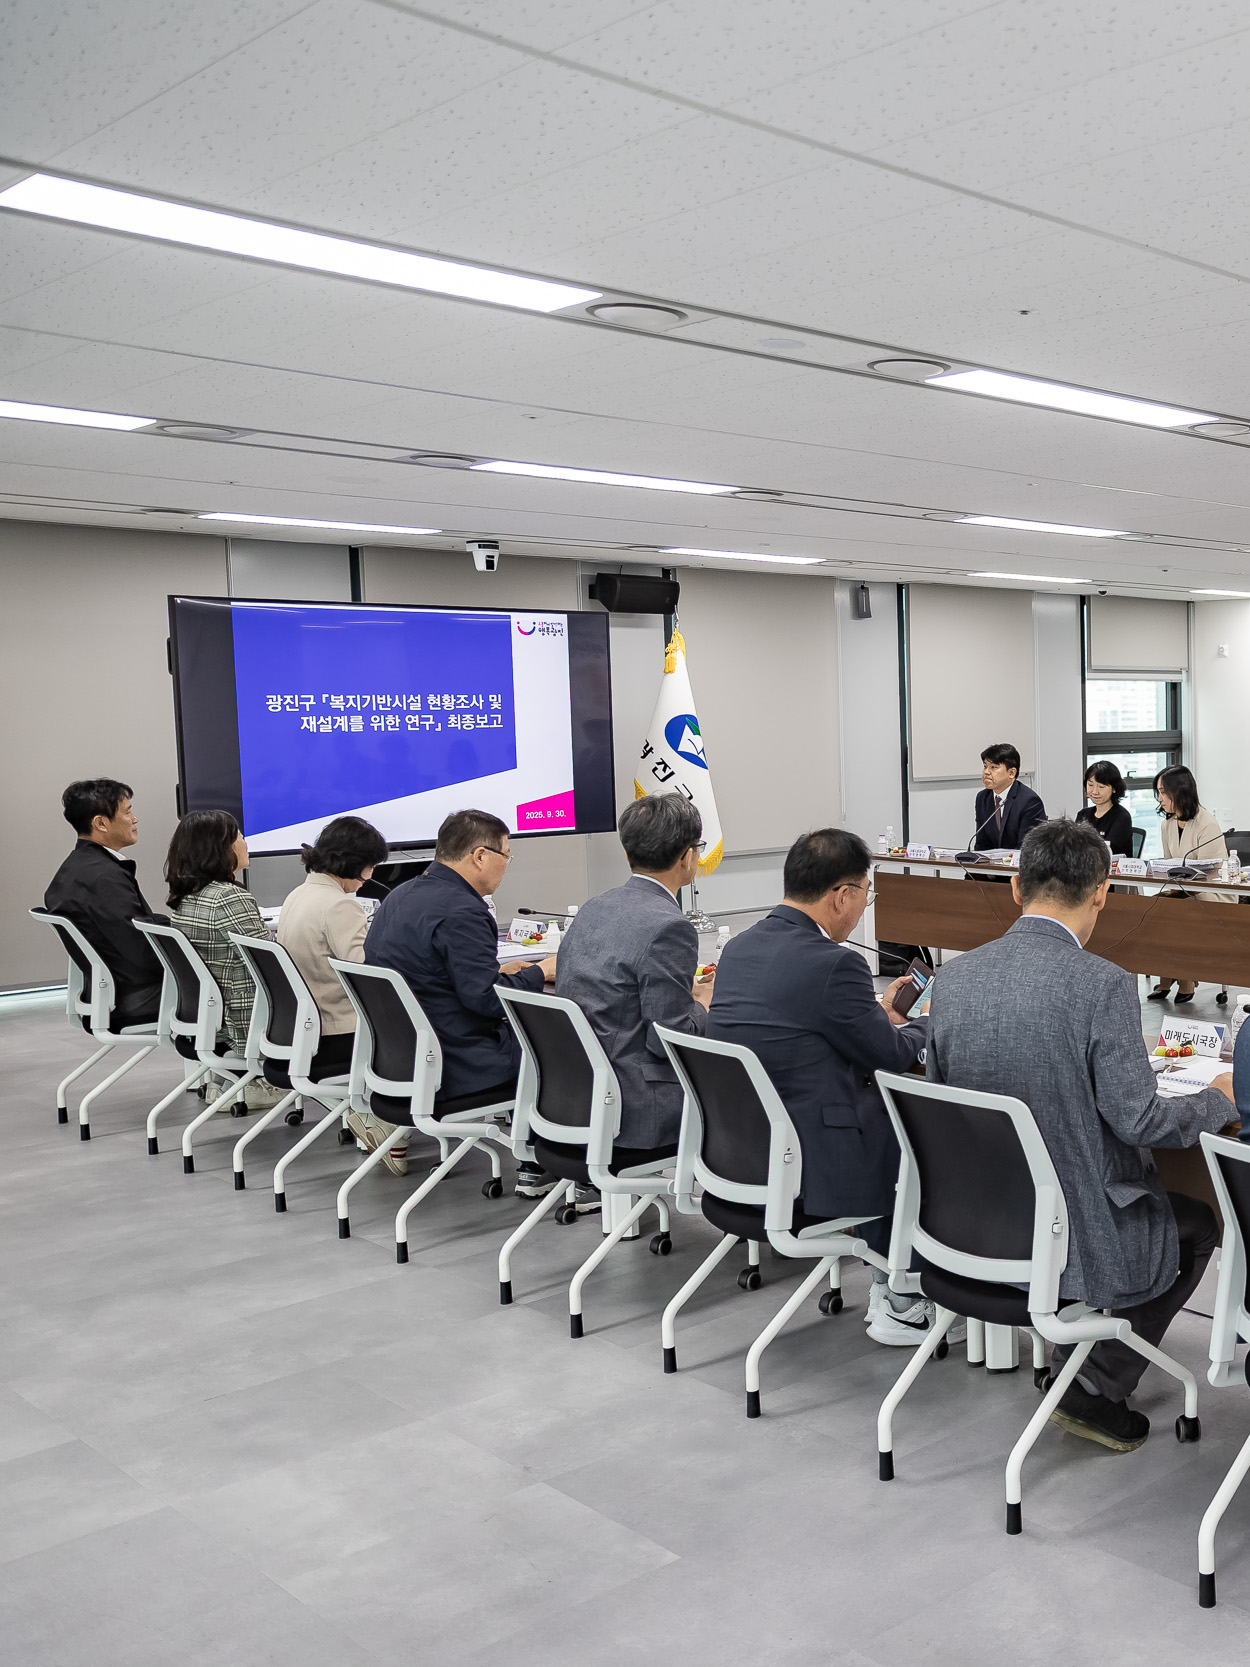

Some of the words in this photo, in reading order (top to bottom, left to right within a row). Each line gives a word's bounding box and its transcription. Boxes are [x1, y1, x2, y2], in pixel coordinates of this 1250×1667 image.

[265, 694, 316, 712] 광진구
[426, 694, 484, 711] 현황조사
[488, 693, 502, 710] 및
[300, 715, 364, 733] 재설계를
[370, 715, 401, 731] 위한
[447, 714, 504, 730] 최종보고
[525, 811, 545, 820] 2025.
[547, 811, 554, 819] 9.
[555, 810, 567, 818] 30.
[1165, 1030, 1218, 1049] 미래도시국장
